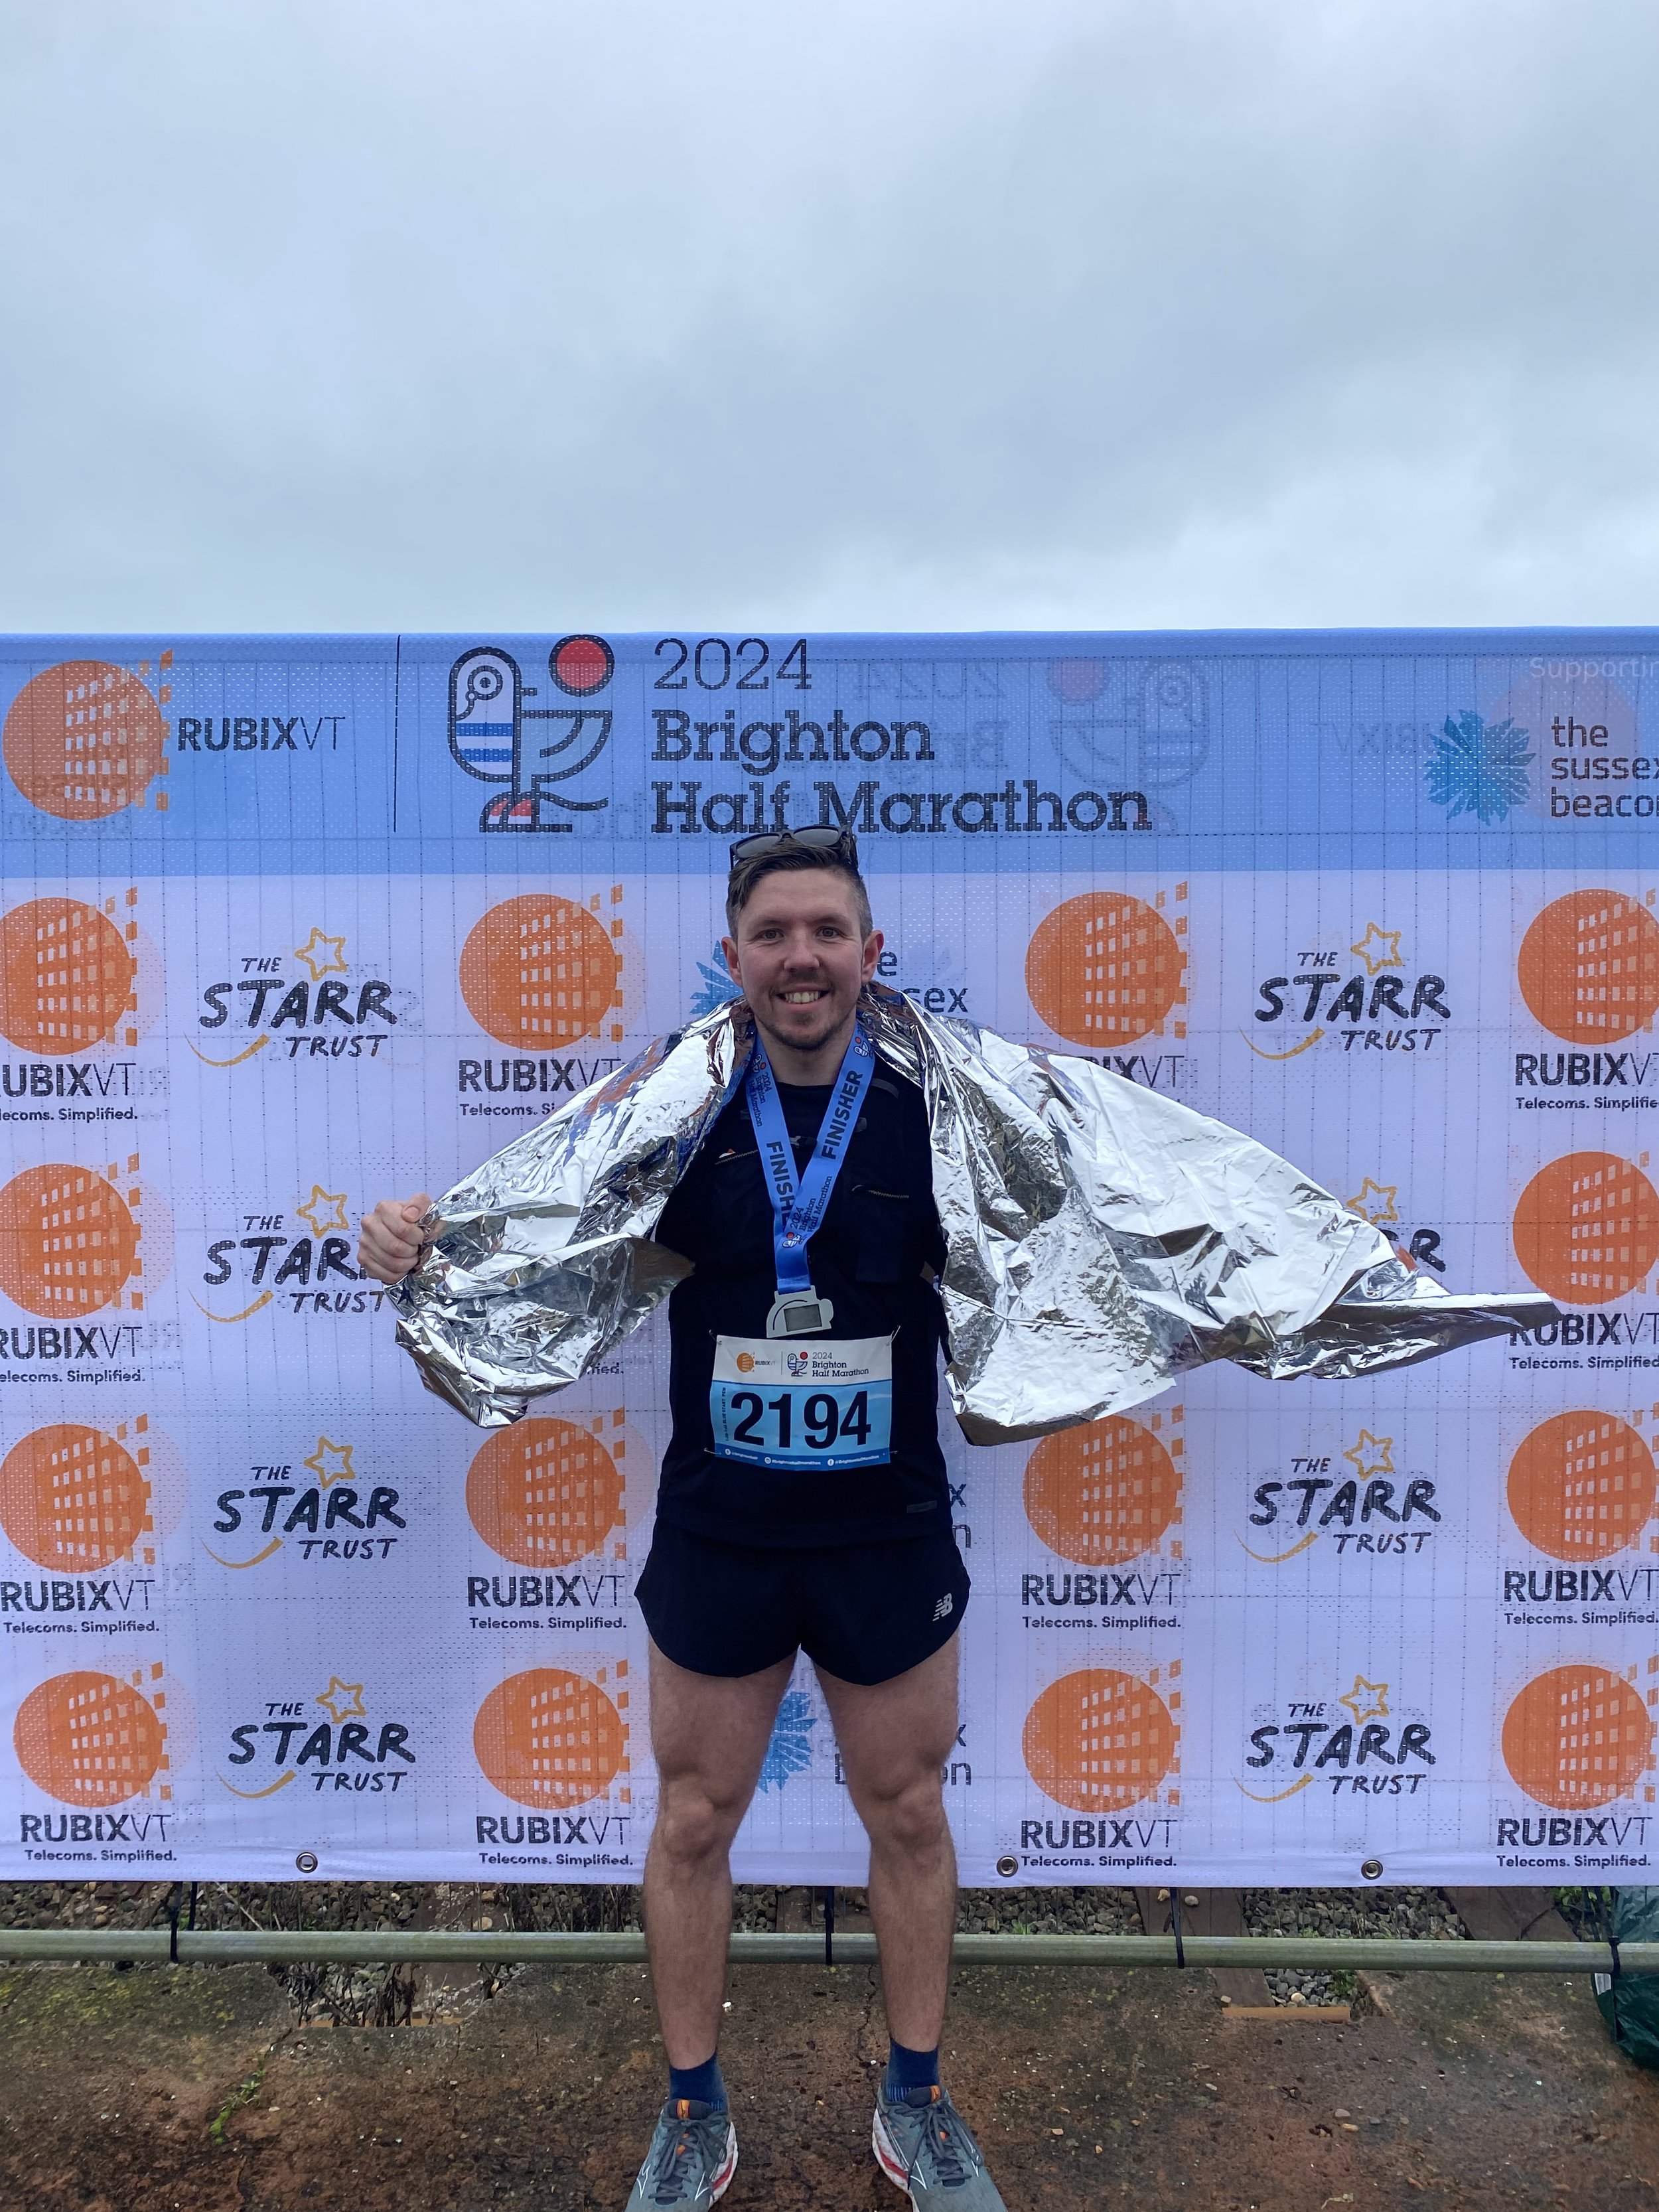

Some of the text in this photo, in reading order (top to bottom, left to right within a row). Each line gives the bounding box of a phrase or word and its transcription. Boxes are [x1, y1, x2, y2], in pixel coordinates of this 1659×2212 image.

[654, 638, 812, 690] 2024
[177, 716, 346, 752] RUBIXVT
[1551, 715, 1609, 747] the
[651, 709, 936, 776] Brighton
[651, 779, 1152, 834] Half Marathon
[1550, 786, 1659, 818] beaco
[241, 957, 282, 973] THE
[1297, 951, 1338, 968] THE
[198, 980, 398, 1029] STARR
[1254, 974, 1451, 1022] STARR
[285, 1035, 388, 1059] TRUST
[1341, 1029, 1441, 1052] TRUST
[1515, 1052, 1659, 1086] RUBIXV
[0, 1063, 137, 1098] UBIXVT
[762, 1072, 772, 1092] 2024
[58, 1106, 138, 1124] Simplified.
[459, 1102, 538, 1116] Telecoms.
[820, 1070, 863, 1160] FINISHER
[1515, 1096, 1659, 1112] Telecoms. Simplifie
[244, 1215, 283, 1230] THE
[790, 1207, 804, 1229] 2024
[203, 1237, 368, 1285] STAR
[289, 1291, 385, 1313] TRUST
[812, 1361, 847, 1370] Brighton
[832, 1368, 869, 1377] Marathon
[1509, 1357, 1583, 1369] Telecoms.
[67, 1369, 145, 1385] Simplified.
[731, 1390, 871, 1449] 2194
[250, 1465, 291, 1481] THE
[1291, 1458, 1331, 1473] THE
[213, 1487, 406, 1533] STARR
[1249, 1479, 1441, 1526] STARR
[296, 1538, 397, 1559] TRUST
[1333, 1532, 1431, 1554] TRUST
[0, 1580, 155, 1611] RUBIXVT
[467, 1575, 625, 1607] RUBIXVT
[1022, 1574, 1181, 1605] RUBIXVT
[1504, 1570, 1659, 1601] RUBIXVT
[3, 1621, 160, 1635] Telecoms. Simplified.
[469, 1617, 627, 1631] Telecoms. Simplified.
[1023, 1615, 1181, 1631] Telecoms. Simplified.
[1504, 1613, 1578, 1624] Telecoms.
[265, 1702, 303, 1716] THE
[1287, 1703, 1327, 1718] THE
[228, 1723, 416, 1765] STARR
[1246, 1724, 1437, 1769] STARR
[311, 1772, 407, 1791] TRUST
[1329, 1774, 1427, 1794] TRUST
[20, 1814, 171, 1842] RUBIXVT
[476, 1816, 630, 1845] RUBIXVT
[1021, 1820, 1178, 1848] RUBIXVT
[1497, 1817, 1653, 1846] RUBIXVT
[25, 1850, 177, 1863] Telecoms. Simplified.
[479, 1852, 633, 1868] Telecoms. Simplified.
[1021, 1856, 1177, 1869] Telecoms. Simplified.
[1496, 1854, 1651, 1869] Telecoms. Simplified.
